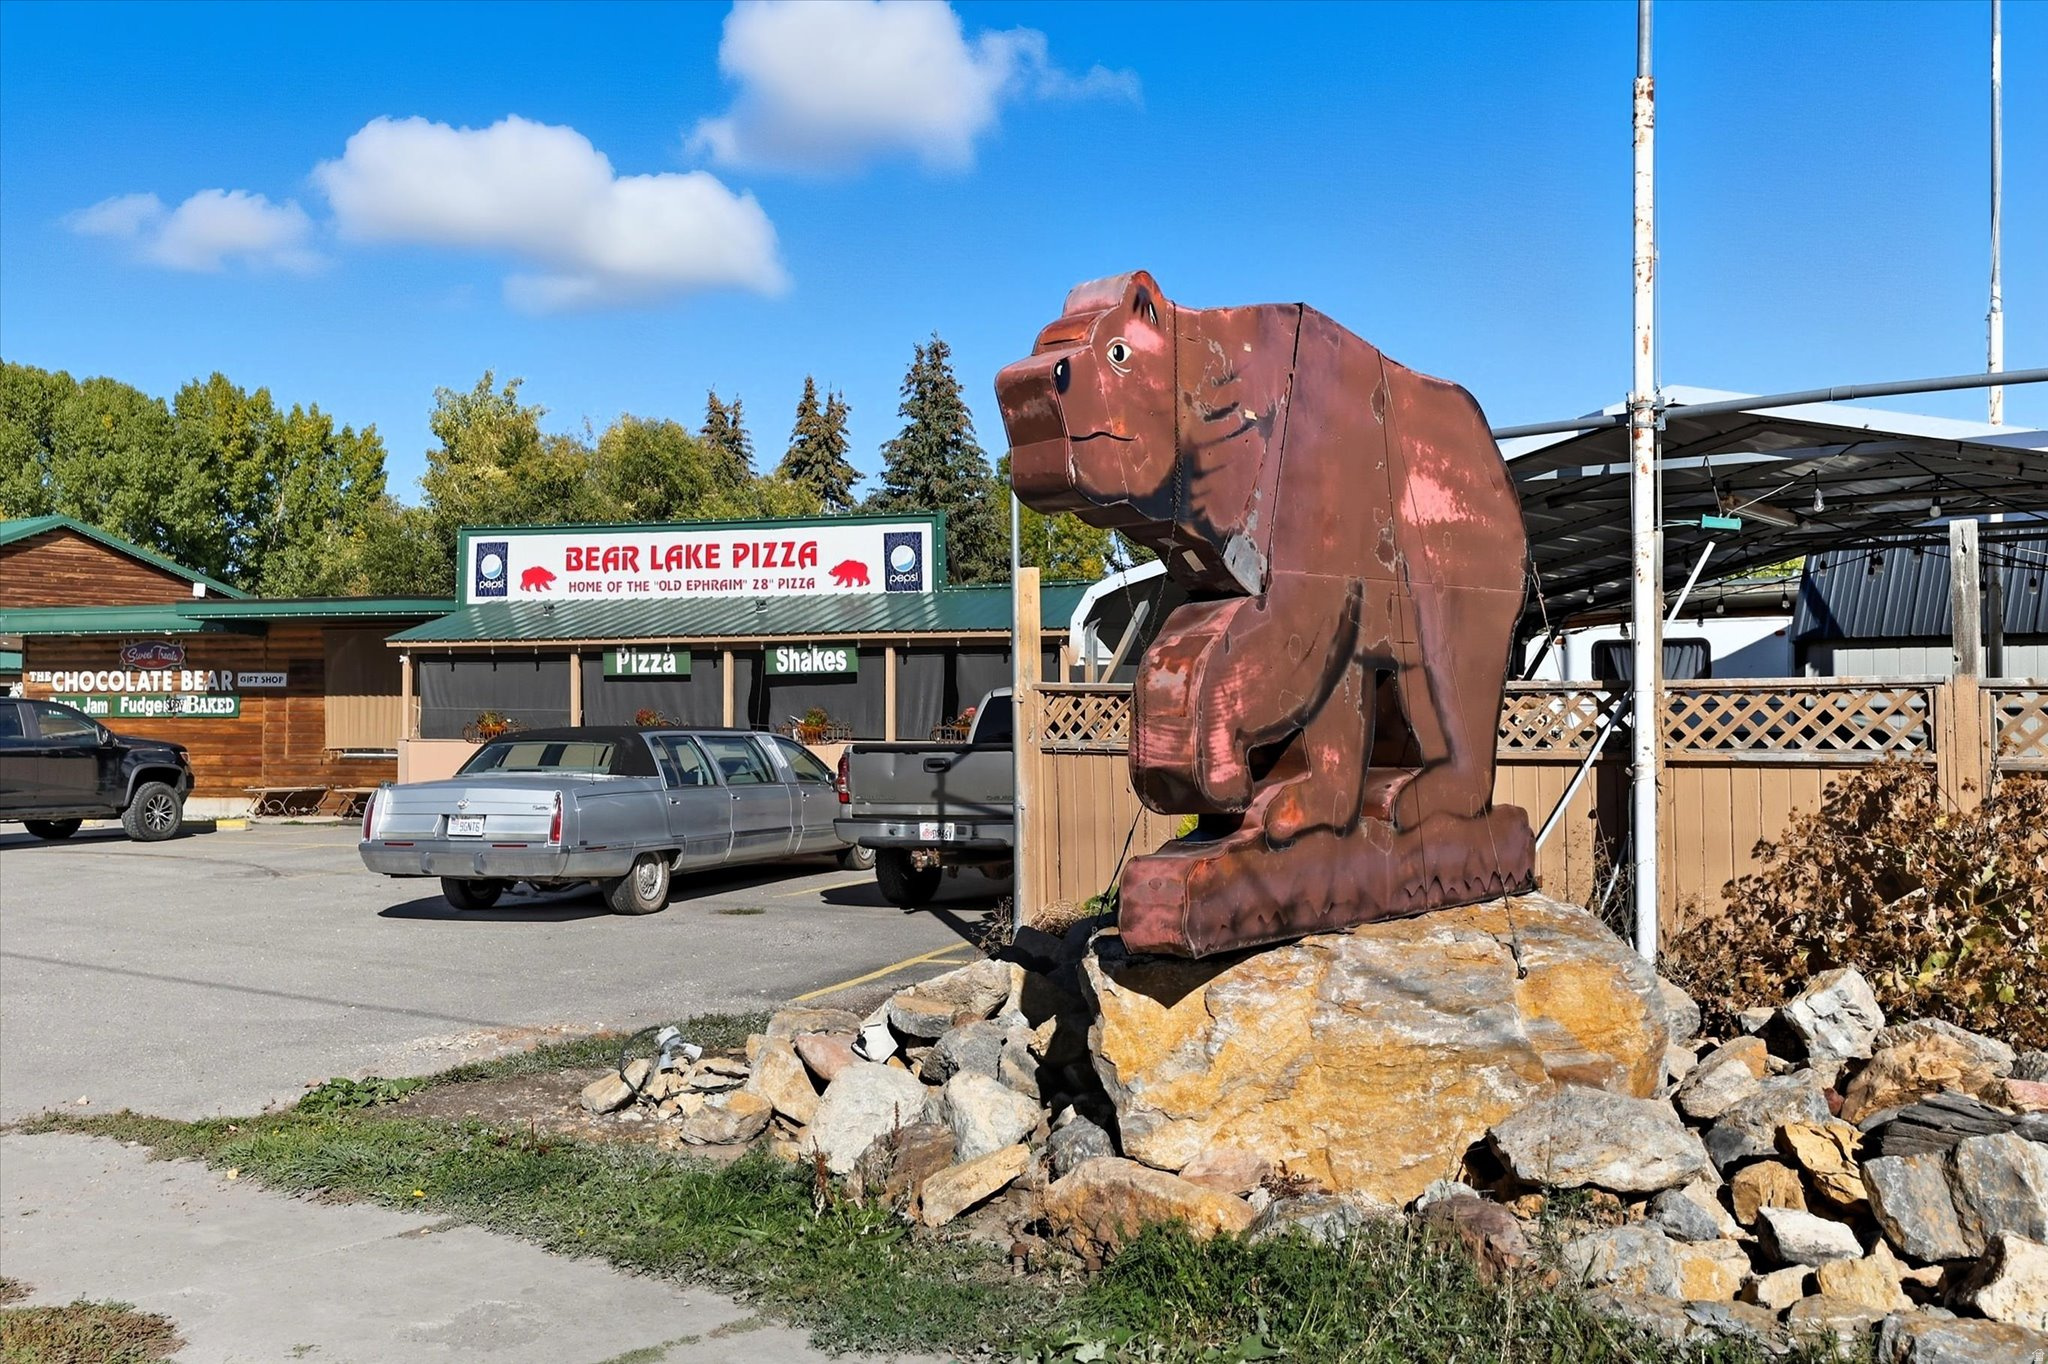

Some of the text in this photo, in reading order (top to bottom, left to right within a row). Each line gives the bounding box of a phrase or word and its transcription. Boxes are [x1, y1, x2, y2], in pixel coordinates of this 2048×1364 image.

[565, 540, 818, 574] BEAR LAKE PIZZA
[479, 579, 504, 591] pepsi
[568, 580, 602, 593] HOME
[607, 580, 622, 593] OF
[627, 580, 650, 592] THE
[778, 577, 815, 590] PIZZA
[889, 572, 919, 585] pepsi
[616, 647, 677, 674] Pizza
[775, 645, 847, 673] Shakes
[28, 670, 234, 692] THE CHOCOLATE BEAR
[239, 676, 284, 684] GIFT SHOP
[83, 697, 109, 714] Jam
[185, 695, 235, 714] BAKED
